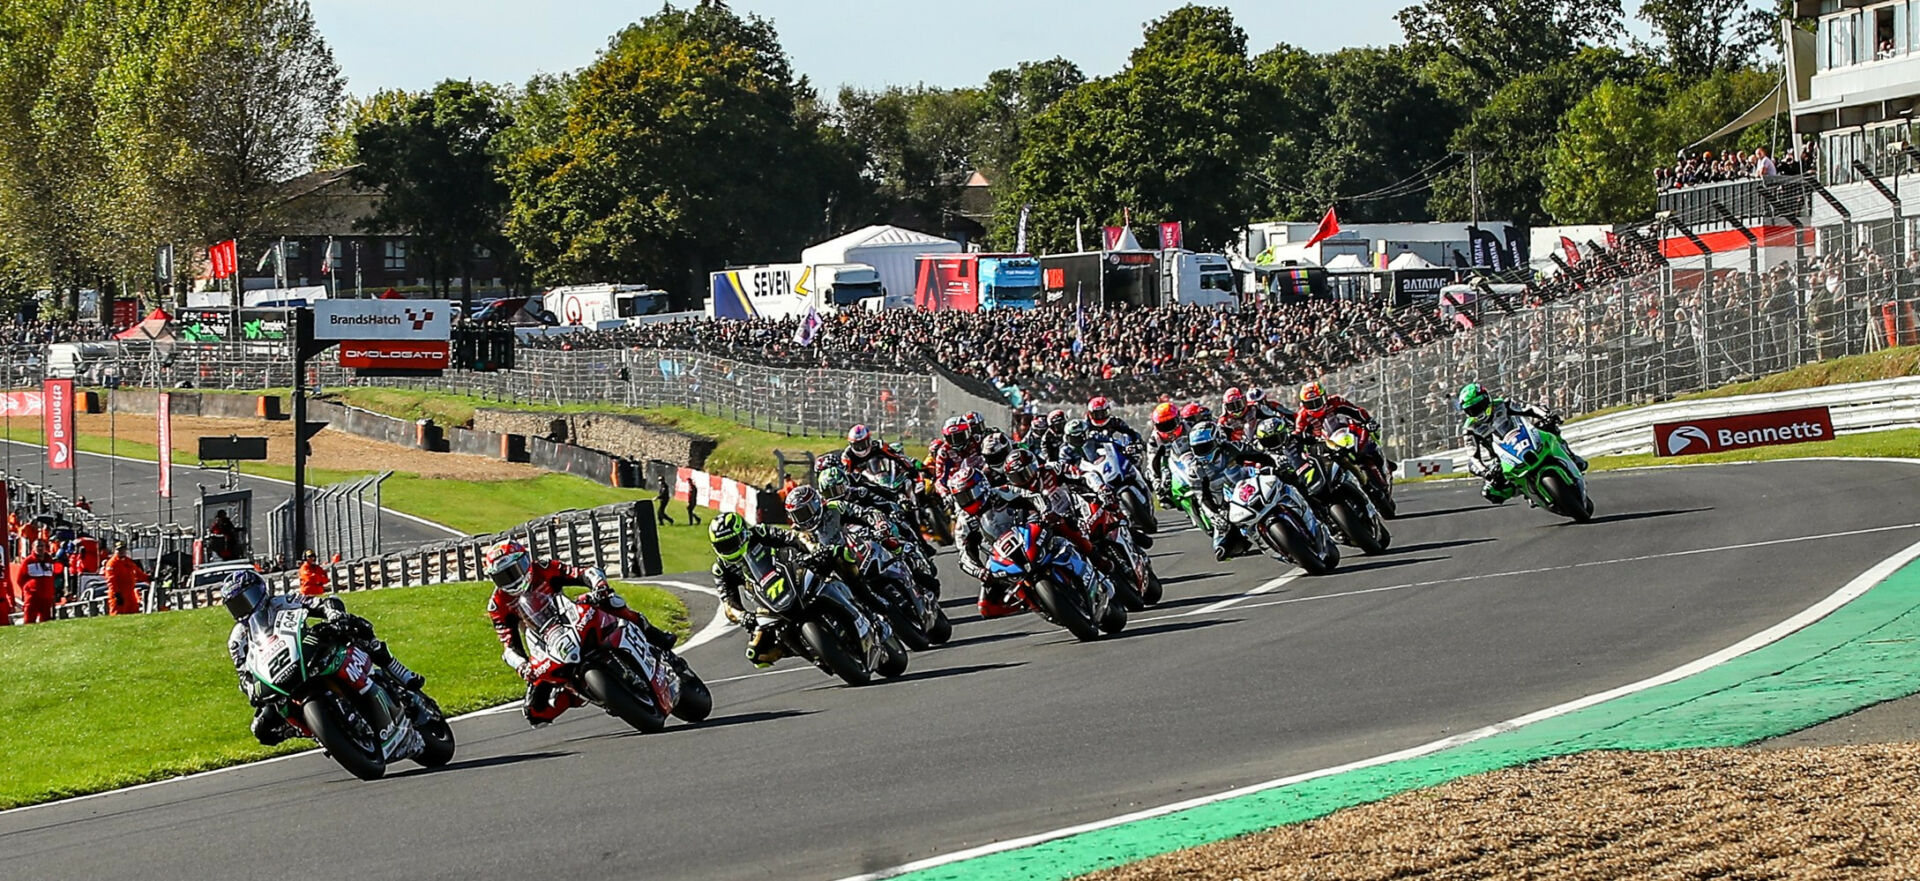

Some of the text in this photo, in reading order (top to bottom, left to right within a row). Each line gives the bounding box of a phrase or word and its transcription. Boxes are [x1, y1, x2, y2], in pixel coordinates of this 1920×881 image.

[1510, 240, 1521, 268] ATATAG
[754, 270, 791, 297] SEVEN
[330, 314, 401, 325] BrandsHatch
[345, 350, 443, 359] OMOLOGATO
[1718, 421, 1823, 446] Bennetts
[1103, 462, 1112, 474] 4
[766, 576, 784, 599] 77
[267, 647, 291, 679] 22
[346, 646, 370, 682] McAM
